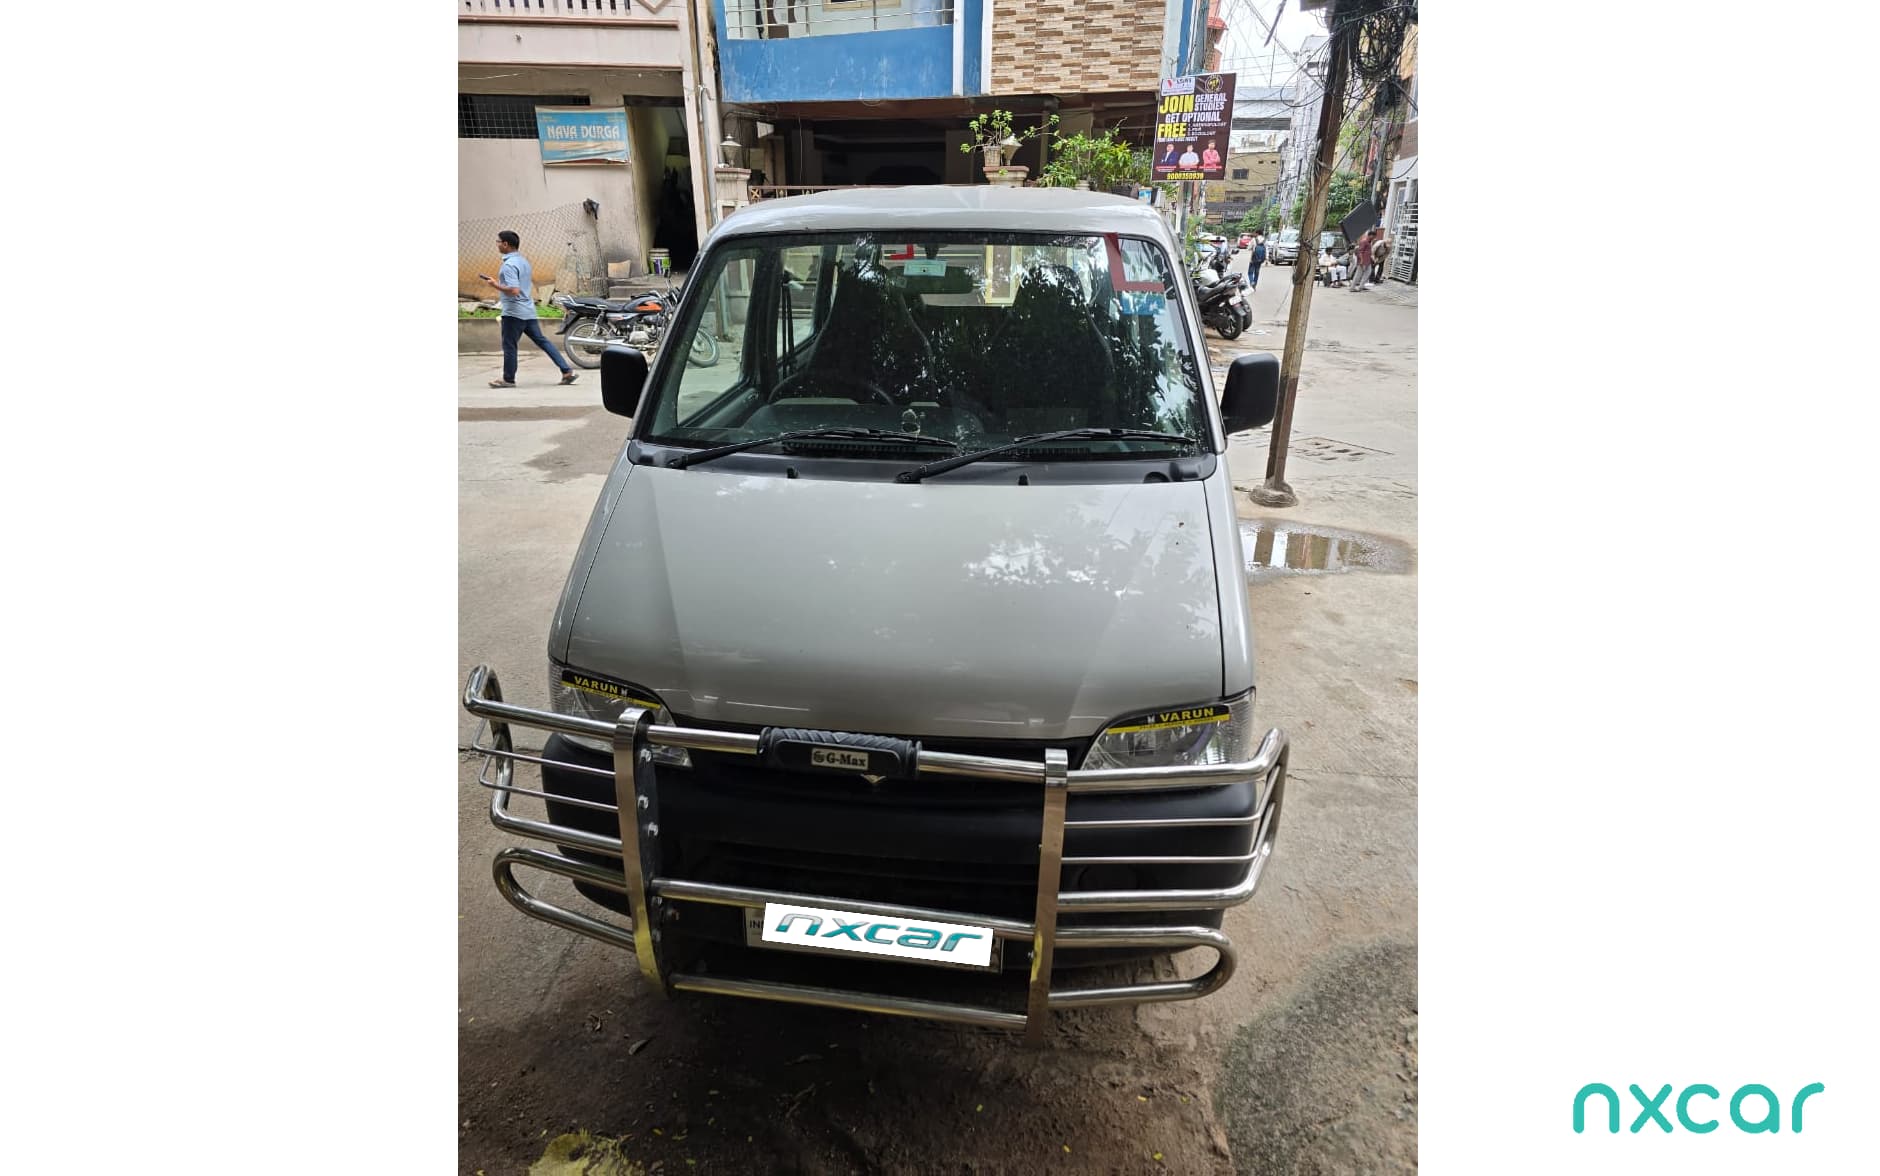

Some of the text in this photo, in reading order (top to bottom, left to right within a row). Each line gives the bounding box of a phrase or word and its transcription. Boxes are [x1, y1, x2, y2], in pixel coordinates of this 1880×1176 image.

[1160, 95, 1194, 113] JOIN
[1195, 93, 1227, 102] GENERAL
[1194, 102, 1224, 111] STUDIES
[1165, 111, 1221, 124] GET OPTIONAL
[547, 125, 619, 139] NAVA DURGA
[1157, 122, 1187, 138] FREE
[574, 676, 618, 694] VARUN
[1160, 707, 1214, 722] VARUN
[826, 752, 866, 767] G-Max
